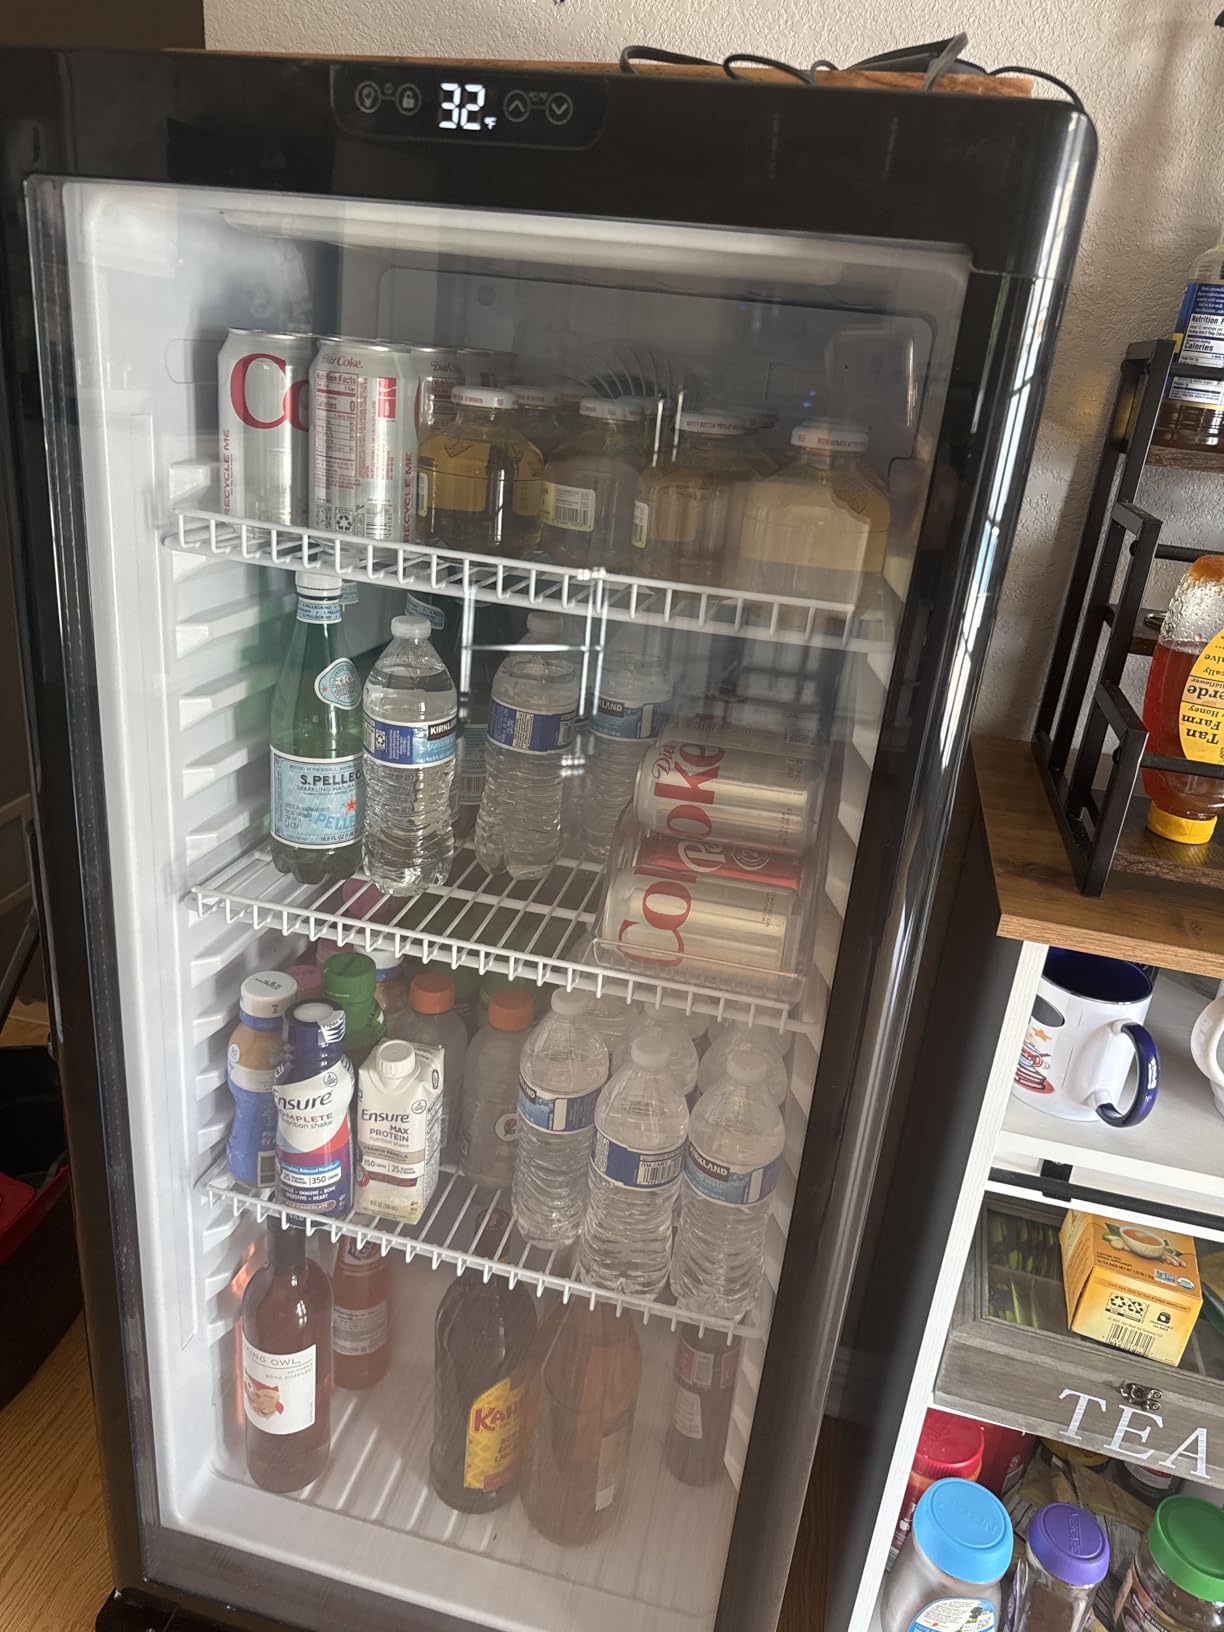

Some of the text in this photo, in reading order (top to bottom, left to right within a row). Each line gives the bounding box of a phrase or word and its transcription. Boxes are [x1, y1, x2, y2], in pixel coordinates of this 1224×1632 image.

[438, 82, 486, 130] 32
[1192, 315, 1219, 325] Nutrition
[1184, 342, 1214, 352] Calories
[224, 428, 231, 450] ME
[403, 452, 413, 543] RECYCLE ME
[1188, 704, 1219, 718] Honey
[1181, 713, 1221, 731] Farm
[1186, 728, 1219, 745] Tan
[361, 1109, 410, 1124] Ensure
[369, 1128, 409, 1143] PROTEIN
[389, 1125, 409, 1135] MAX
[364, 1159, 376, 1168] 150
[391, 1164, 400, 1174] 25
[312, 1175, 327, 1185] 350
[1059, 1388, 1211, 1480] TEA
